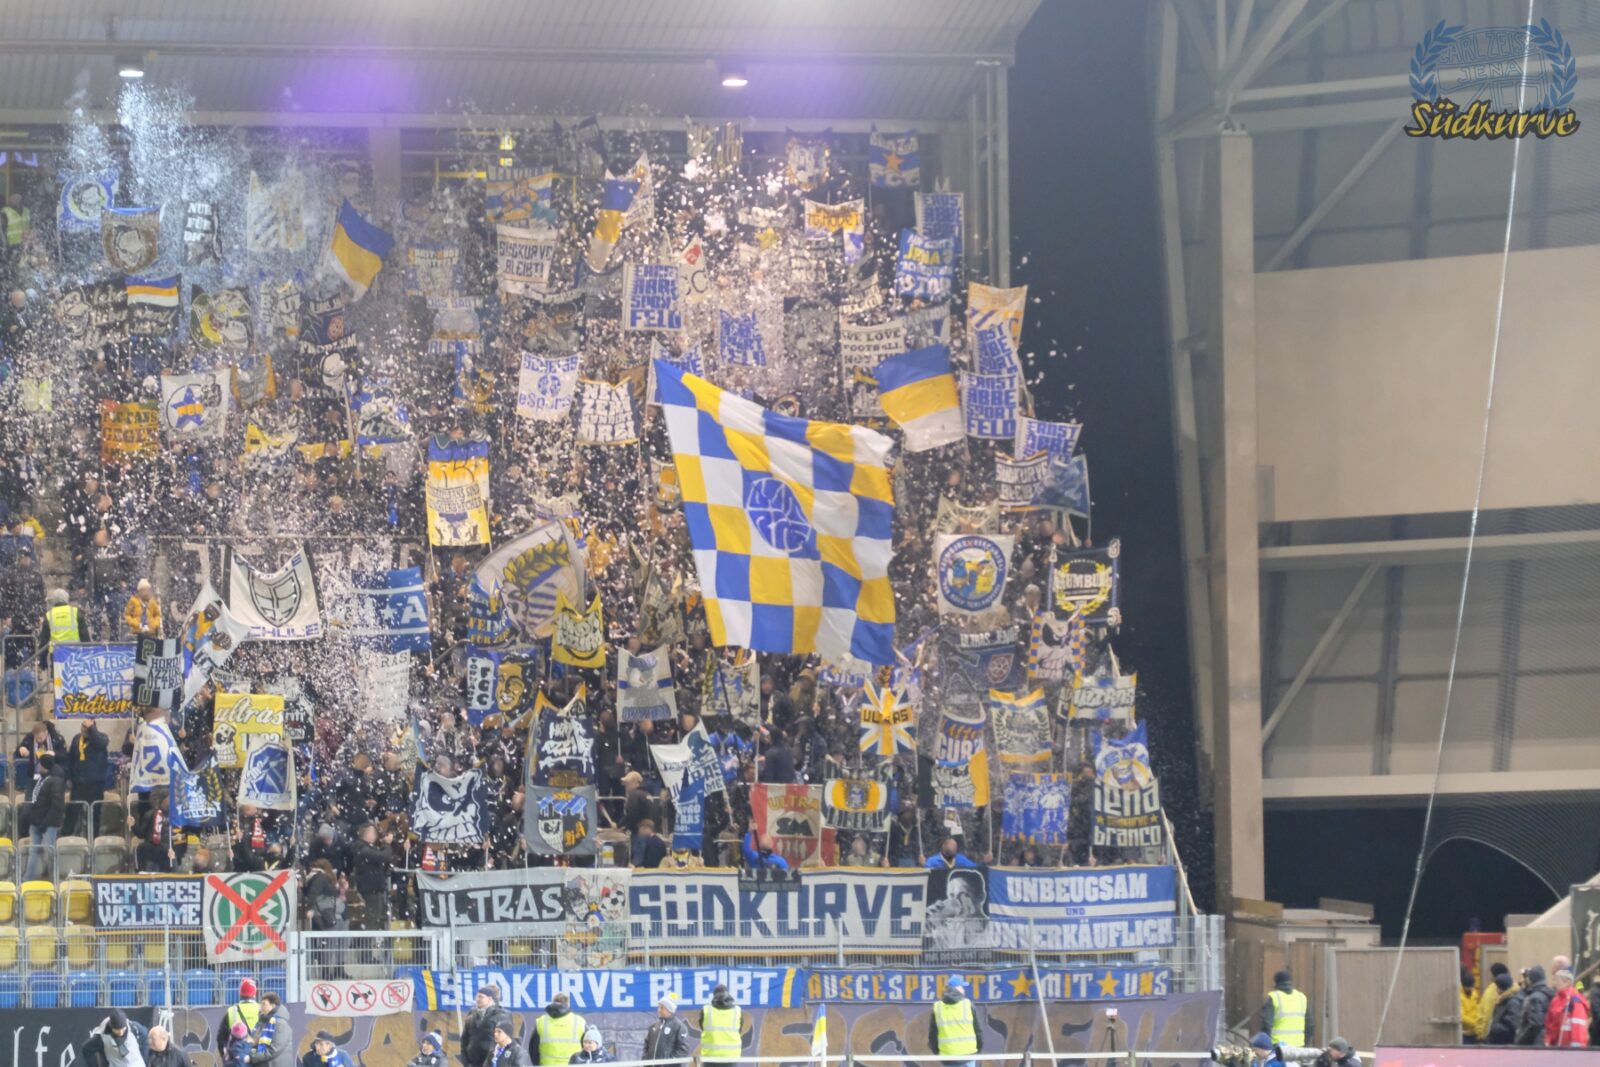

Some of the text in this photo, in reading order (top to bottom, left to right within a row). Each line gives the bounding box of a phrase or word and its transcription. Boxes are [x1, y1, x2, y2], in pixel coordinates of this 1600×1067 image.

[866, 329, 901, 341] LOVE
[966, 418, 1017, 437] FELD
[215, 697, 284, 725] ultras
[1094, 825, 1161, 846] branco
[97, 881, 201, 904] REFUGEES
[1006, 873, 1148, 903] UNBEUGSAM
[98, 903, 201, 926] WELCOME
[424, 886, 563, 926] ULTRAS
[629, 881, 924, 939] SÜDKURVE
[1065, 907, 1086, 916] UND
[439, 968, 635, 1009] SÜDKURVE
[1040, 971, 1093, 998] MIT
[1123, 970, 1168, 997] UNS
